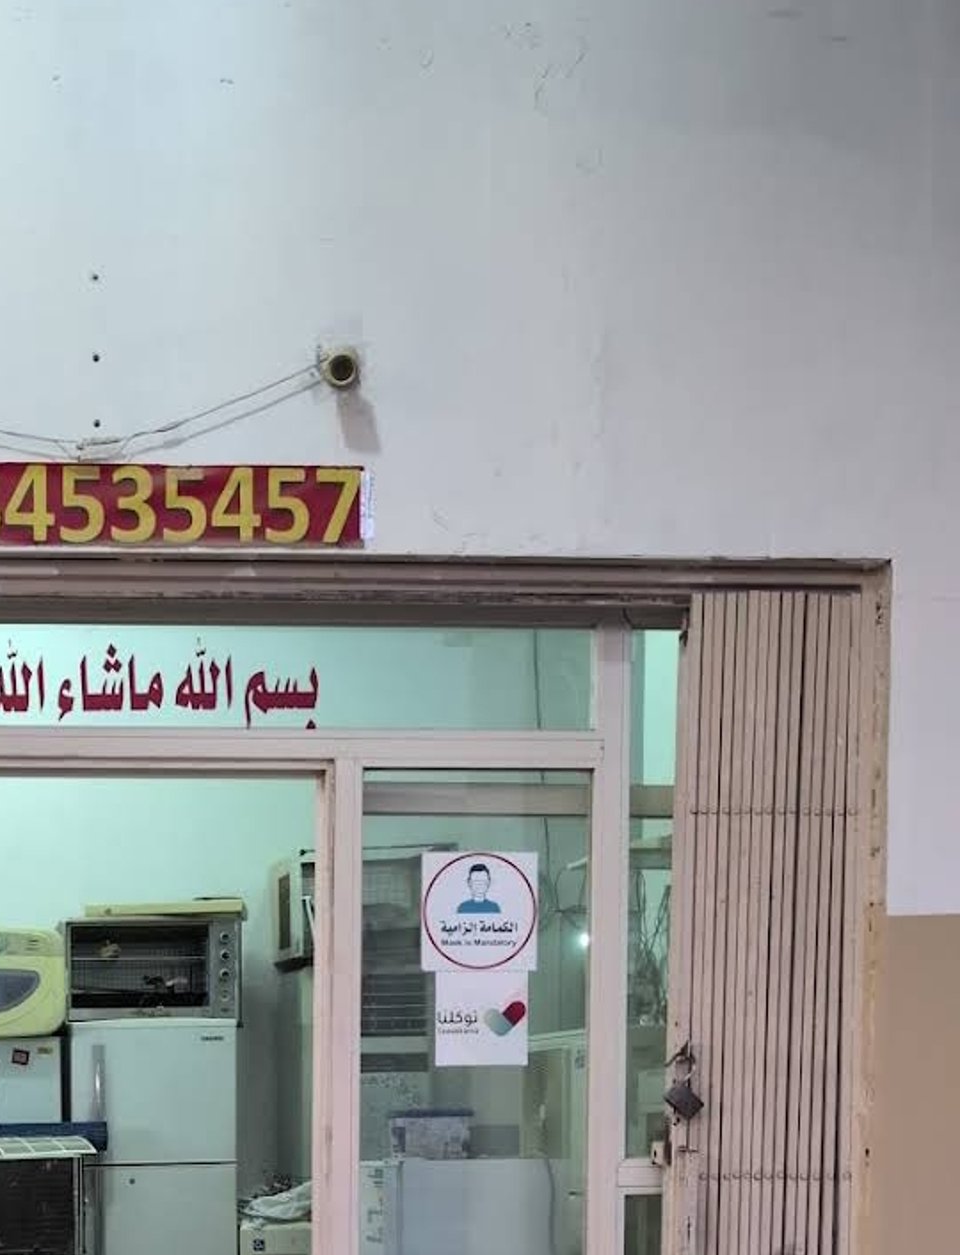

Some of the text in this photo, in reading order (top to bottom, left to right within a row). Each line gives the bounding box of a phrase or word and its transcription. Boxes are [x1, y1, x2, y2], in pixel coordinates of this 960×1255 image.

[175, 637, 233, 711] الله
[244, 666, 319, 730] بسم
[480, 920, 519, 933] الكمامة
[474, 938, 518, 948] Mandatory
[437, 1009, 478, 1027] توكلنا
